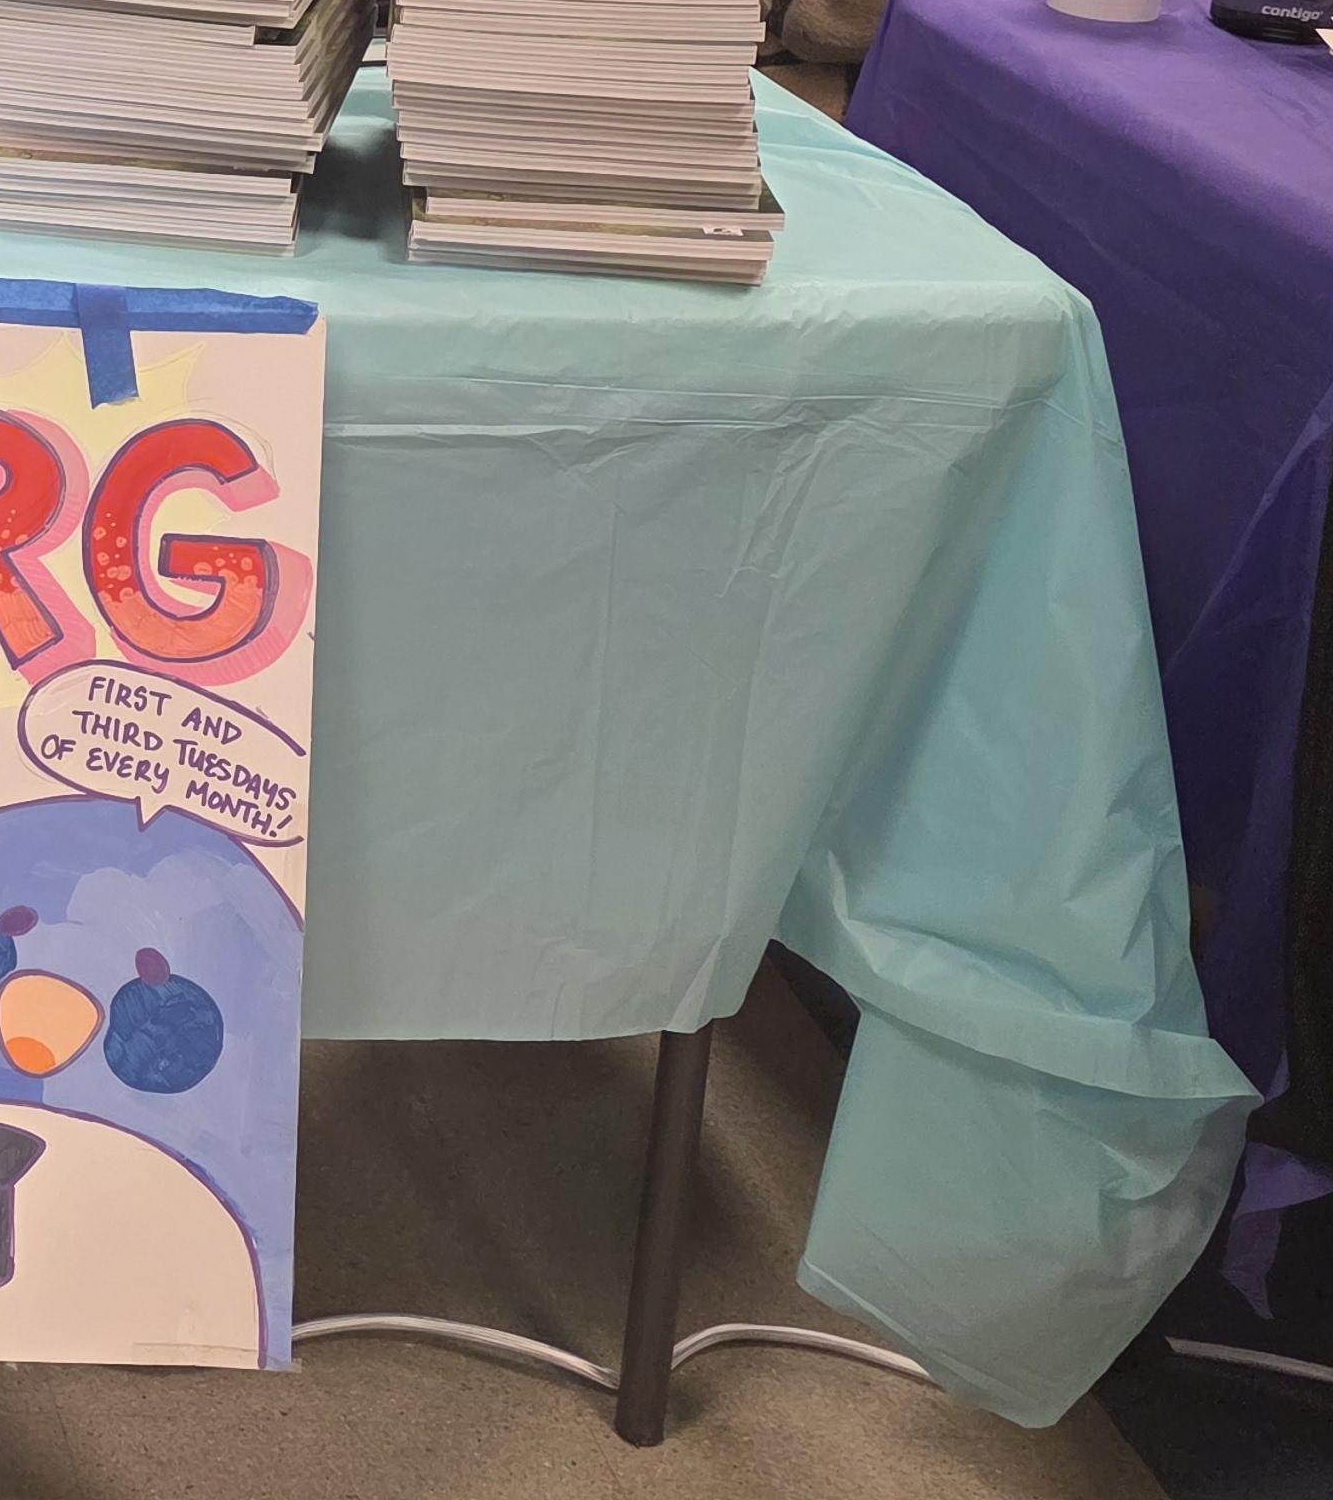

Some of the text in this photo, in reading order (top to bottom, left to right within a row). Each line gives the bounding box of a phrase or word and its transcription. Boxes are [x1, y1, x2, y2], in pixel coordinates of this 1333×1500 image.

[72, 710, 297, 811] THIRD TUESDAYS
[88, 675, 243, 745] FIRST AND
[40, 734, 294, 838] OF EVERY MONTH!
